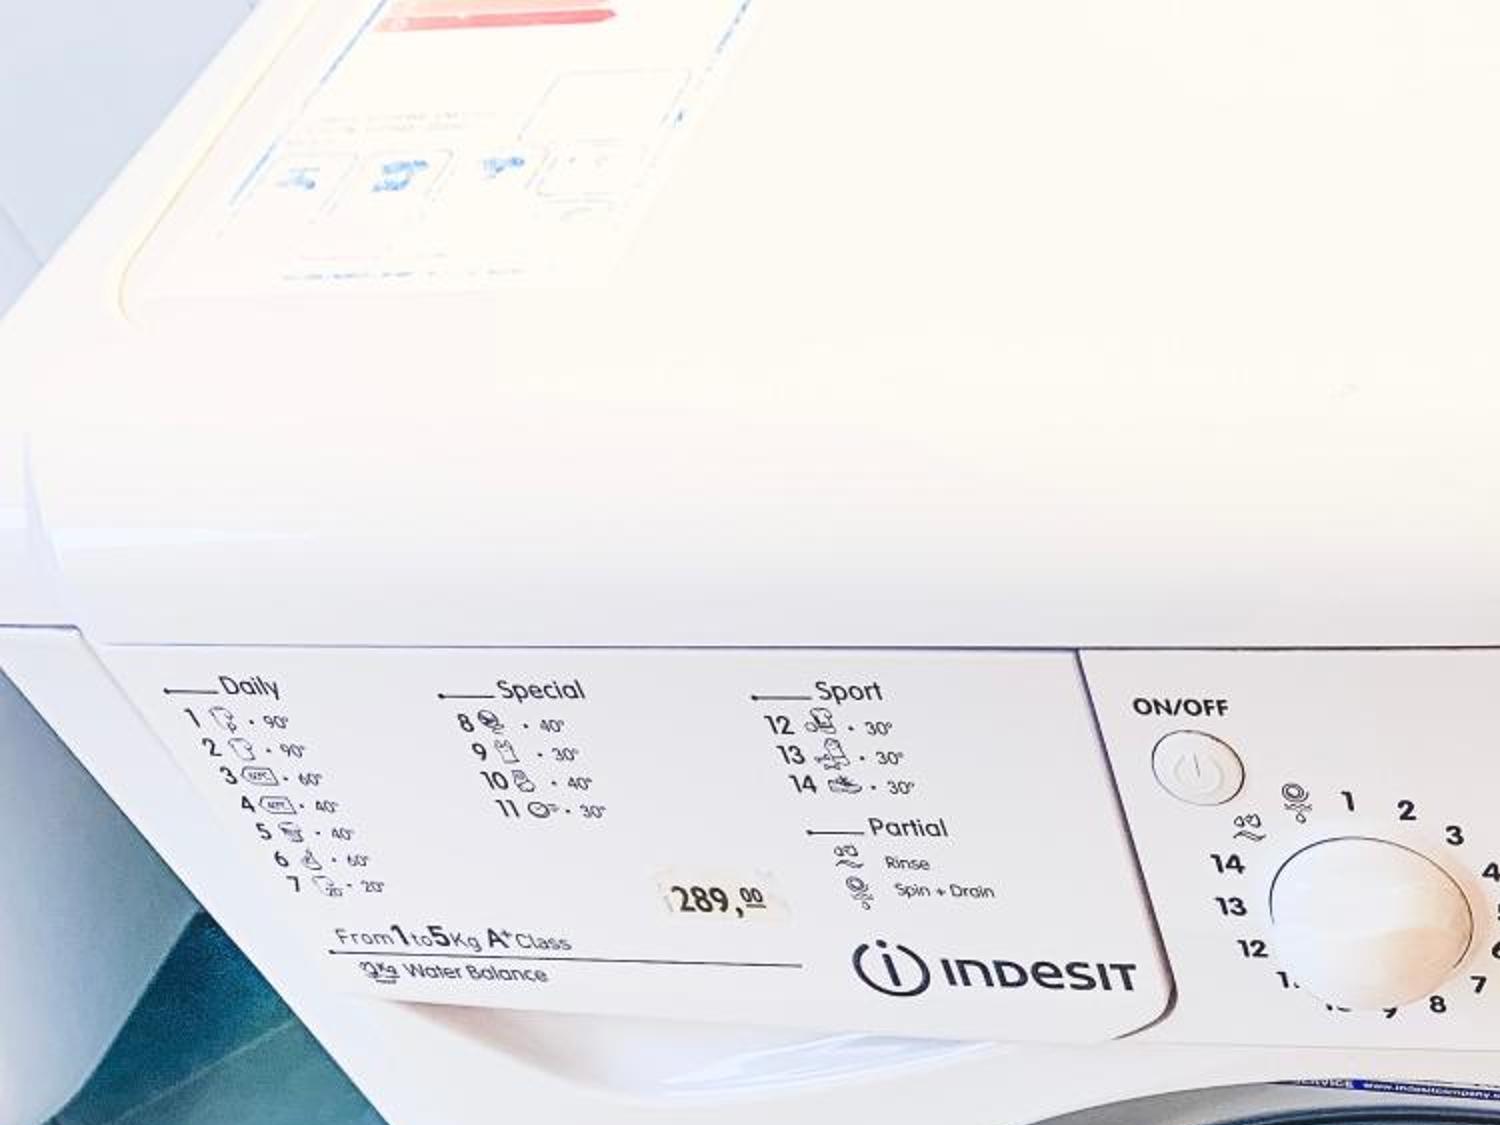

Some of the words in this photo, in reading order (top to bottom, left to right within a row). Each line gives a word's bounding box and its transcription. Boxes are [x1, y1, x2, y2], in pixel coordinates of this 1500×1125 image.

[218, 675, 280, 701] Daily
[496, 679, 586, 703] Special
[815, 681, 884, 705] Sport
[1133, 698, 1229, 717] ON/OFF
[184, 708, 201, 728] 1
[457, 713, 475, 733] 8
[540, 719, 565, 733] 40°
[763, 715, 796, 735] 12
[865, 721, 893, 736] 30°
[202, 737, 222, 757] 2
[471, 742, 487, 761] 9
[776, 745, 806, 765] 13
[876, 751, 904, 765] 30°
[219, 766, 238, 785] 3
[480, 771, 509, 790] 10
[567, 776, 593, 791] 40°
[788, 774, 817, 794] 14
[887, 780, 915, 795] 30°
[241, 795, 256, 813] 4
[495, 799, 520, 818] 11
[1341, 791, 1355, 811] 1
[1397, 799, 1417, 821] 2
[256, 822, 272, 841] 5
[868, 817, 949, 838] Partial
[1445, 826, 1465, 846] 3
[274, 851, 289, 868] 6
[885, 856, 930, 871] Rinse
[1210, 853, 1246, 874] 14
[286, 875, 300, 893] 7
[894, 882, 931, 899] Spin
[950, 884, 995, 898] Drain
[1215, 897, 1247, 917] 13
[335, 927, 395, 945] From
[514, 933, 573, 951] Class
[1237, 939, 1269, 958] 12
[401, 962, 463, 981] Water
[466, 963, 549, 983] Balance
[1470, 974, 1487, 994] 7
[1429, 995, 1447, 1013] 8
